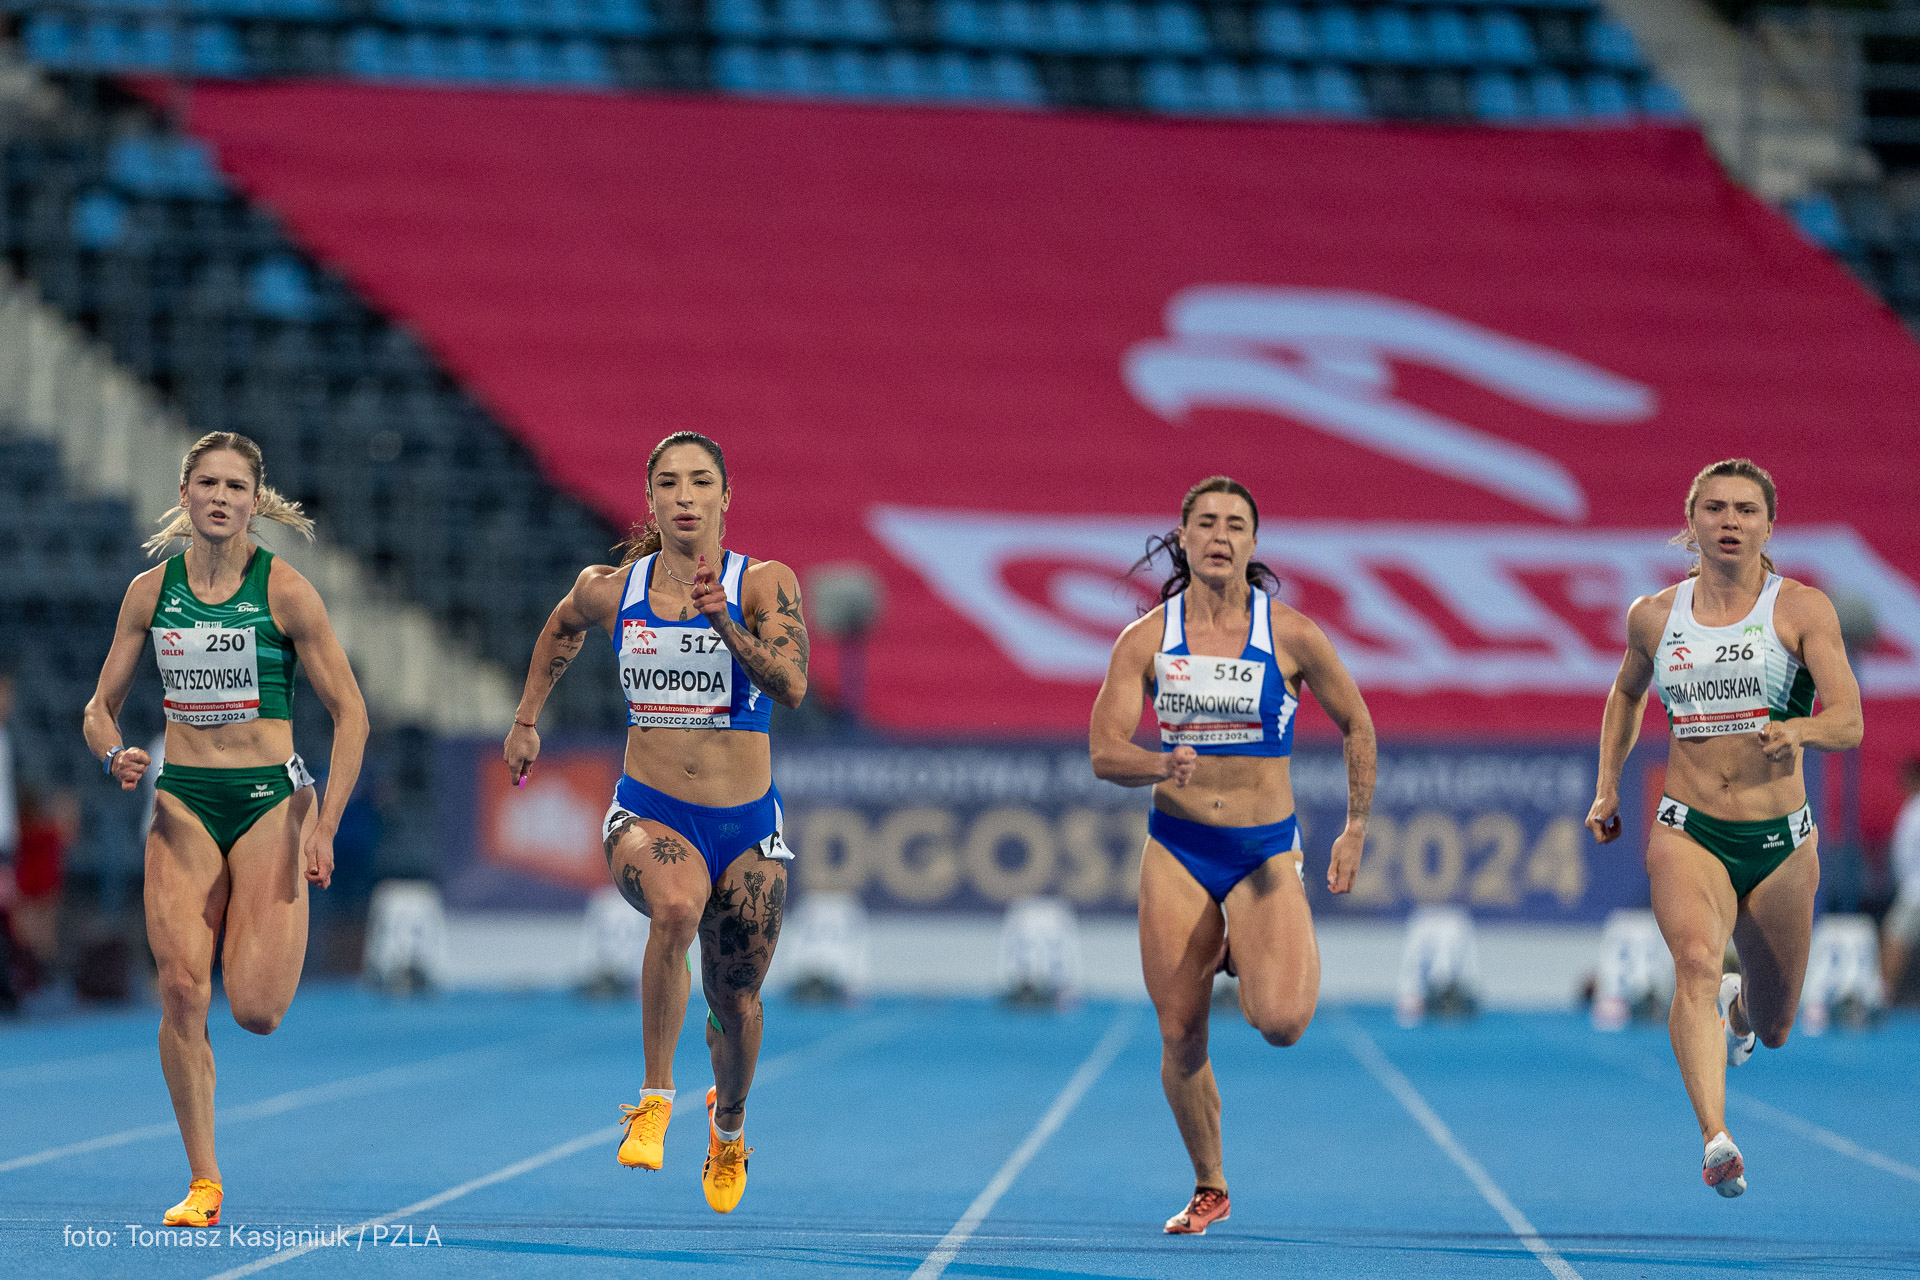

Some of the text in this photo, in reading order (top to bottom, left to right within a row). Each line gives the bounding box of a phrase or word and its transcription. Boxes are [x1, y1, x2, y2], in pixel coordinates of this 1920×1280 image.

[206, 633, 245, 652] 250
[680, 634, 721, 654] 517
[1714, 643, 1754, 663] 256
[1214, 664, 1253, 682] 516
[1669, 662, 1694, 672] ORLEN
[623, 668, 725, 693] SWOBODA
[1665, 676, 1762, 704] TSIMANOUSKAYA
[659, 705, 695, 713] Mistrzostwa
[1158, 692, 1254, 715] STEFANOWICZ
[171, 712, 246, 722] BYDGOSZCZ 2024
[634, 715, 715, 725] YDGOSZCZ 2024
[1699, 713, 1735, 722] Mistrzostwa
[1736, 711, 1754, 719] Polski
[1680, 721, 1756, 735] BYDGOSZCZ 2024
[1169, 732, 1249, 741] BYDGOSZCZ 2024
[250, 789, 275, 799] erima
[1659, 804, 1678, 827] 4
[1799, 809, 1811, 839] 4
[1763, 840, 1785, 849] erima
